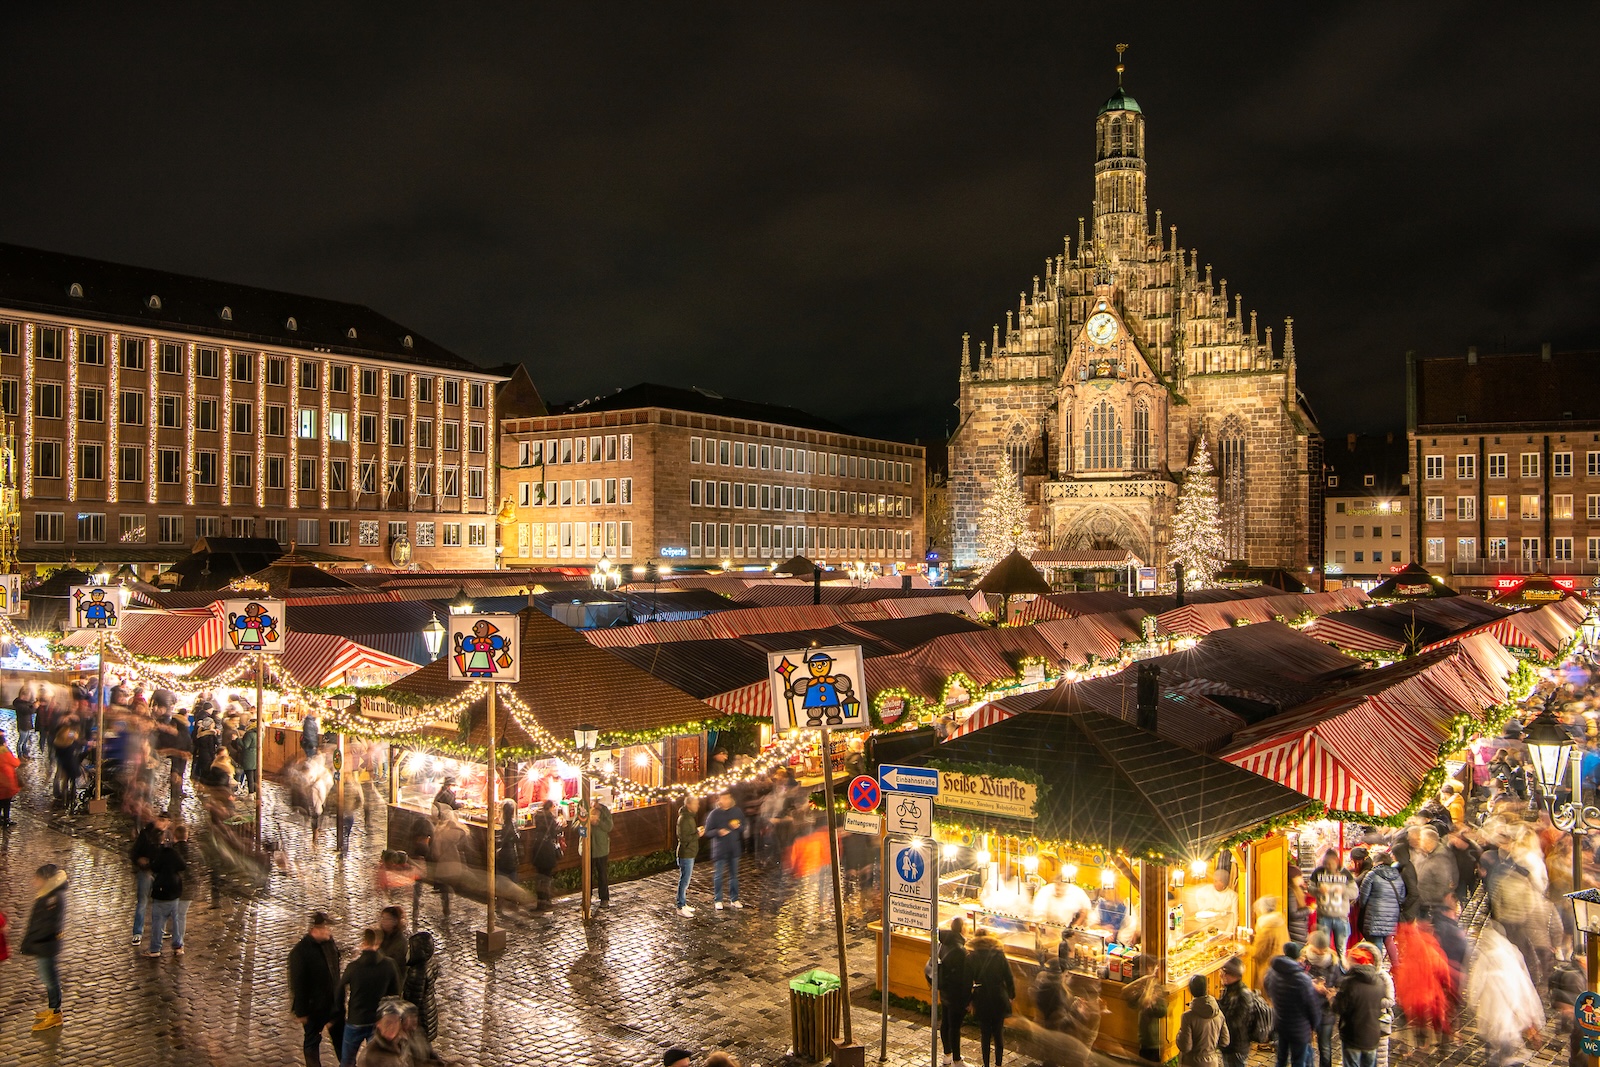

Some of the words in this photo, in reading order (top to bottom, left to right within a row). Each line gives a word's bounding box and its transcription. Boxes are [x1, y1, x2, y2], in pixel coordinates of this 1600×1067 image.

[363, 695, 413, 719] Nürnberger
[896, 775, 936, 786] Einbahnstraße
[943, 773, 977, 794] Heiße
[847, 818, 878, 829] Rettungsweg
[899, 883, 921, 895] ZONE
[1584, 1041, 1598, 1052] WC
